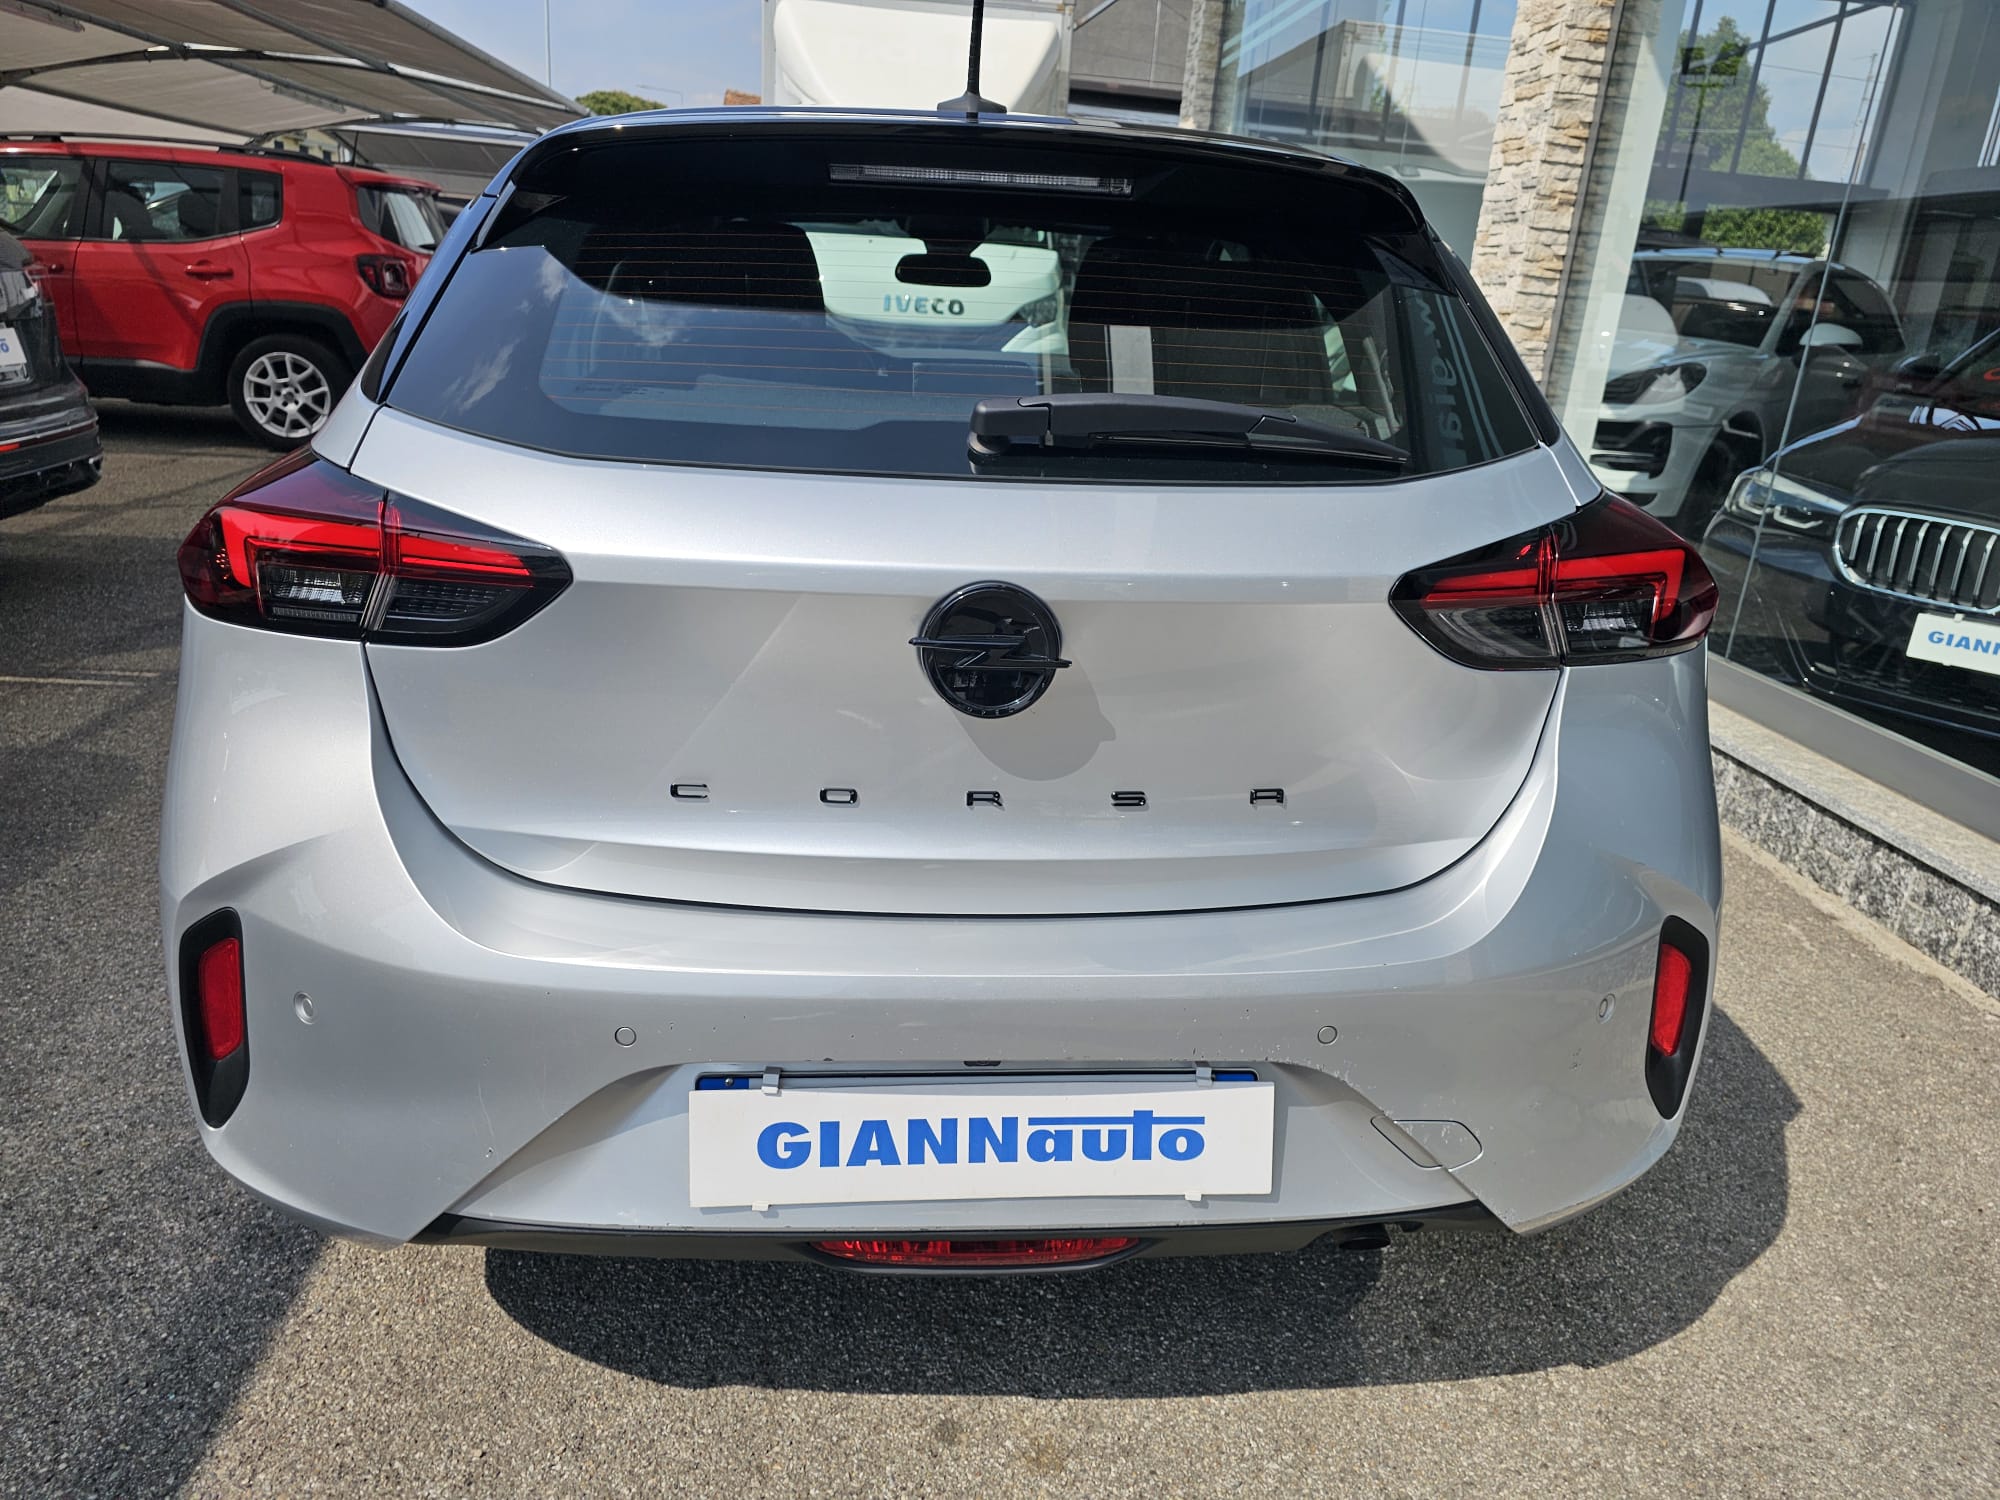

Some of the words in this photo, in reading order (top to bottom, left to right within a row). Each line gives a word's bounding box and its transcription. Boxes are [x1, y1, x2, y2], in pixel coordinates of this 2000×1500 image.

[883, 294, 964, 316] IVECO
[670, 783, 1284, 807] CORSA
[757, 1110, 1205, 1169] GIANNauto
